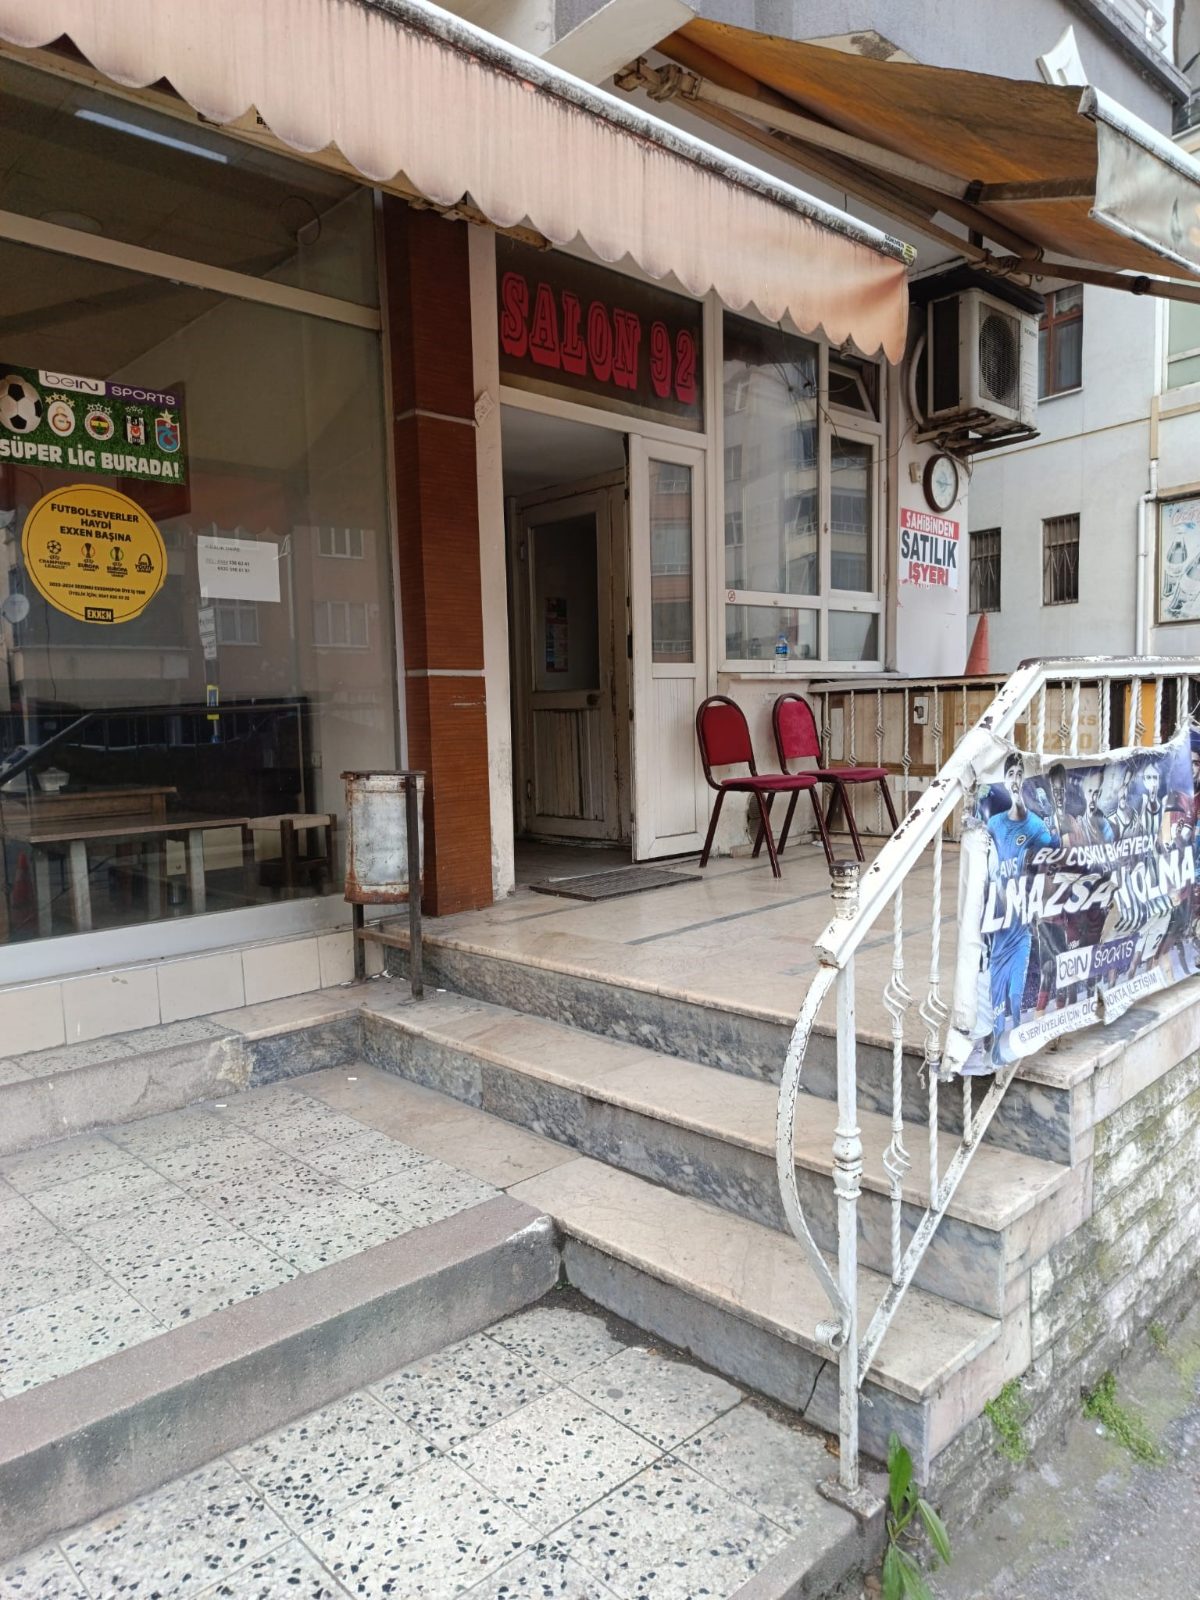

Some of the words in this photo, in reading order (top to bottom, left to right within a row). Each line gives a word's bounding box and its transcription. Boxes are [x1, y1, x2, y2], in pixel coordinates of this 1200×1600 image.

[501, 272, 641, 390] SALON
[650, 321, 698, 405] 92
[111, 386, 176, 405] SPORTS
[0, 436, 63, 464] SÜPER
[68, 444, 96, 467] LİG
[101, 452, 179, 478] BURADA!
[51, 503, 139, 523] FUTBOLSEVERLER
[80, 518, 112, 530] HAYDİ
[60, 526, 93, 538] EXXEN
[95, 530, 132, 542] BAŞINA
[901, 530, 957, 568] SATILIK
[86, 609, 112, 620] EXXEN
[1032, 847, 1067, 865] BU
[1066, 843, 1103, 869] COŞKU
[1094, 940, 1134, 968] SPORTS
